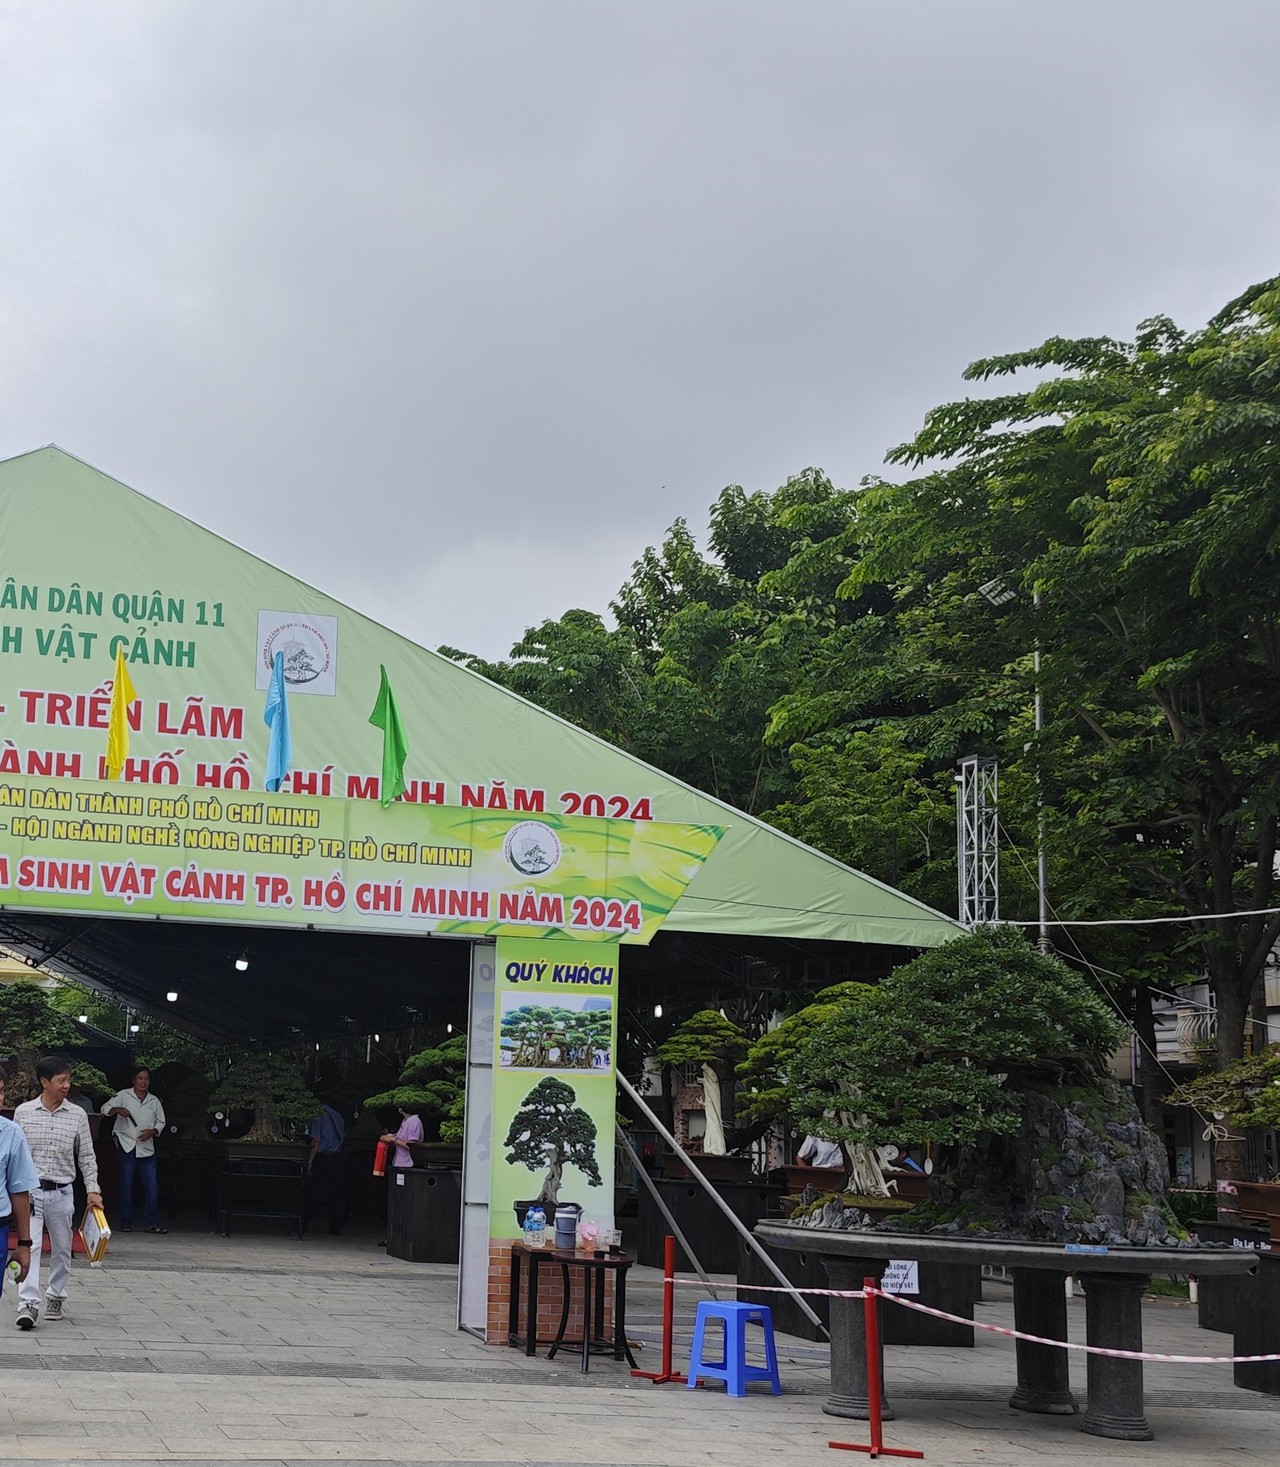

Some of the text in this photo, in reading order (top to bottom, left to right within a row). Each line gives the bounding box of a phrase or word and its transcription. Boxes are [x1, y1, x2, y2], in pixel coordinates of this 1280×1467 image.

[48, 583, 103, 616] DÂN
[112, 590, 184, 627] QUẬN
[195, 601, 225, 628] 11
[35, 624, 97, 663] VẬT
[109, 627, 196, 668] CẢNH
[158, 696, 244, 740] LÃM
[29, 787, 74, 811] DÂN
[76, 789, 143, 816] THÀNH
[148, 794, 189, 820] PHỐ
[193, 797, 223, 823] HỒ
[226, 799, 261, 825] CHÍ
[266, 805, 320, 829] MINH
[196, 752, 250, 790] HỒ
[347, 775, 445, 805] MNH
[461, 780, 545, 813] NĂM
[560, 792, 654, 821] 2024
[11, 815, 48, 842] HỘI
[52, 816, 122, 844] NGÀNH
[127, 822, 181, 849] NGHỀ
[184, 827, 238, 852] NÔNG
[243, 832, 316, 859] NGHIỆP
[319, 840, 346, 860] TP.
[349, 836, 377, 862] HỒ
[381, 842, 417, 865] CHÍ
[421, 847, 472, 868] MINH
[20, 859, 90, 892] SINH
[101, 861, 156, 901] VẬT
[163, 860, 245, 900] CẢNH
[255, 876, 293, 904] TP.
[304, 869, 346, 908] HỒ
[356, 875, 402, 911] CHÍ
[412, 887, 489, 918] MINH
[499, 888, 563, 923] NĂM
[572, 900, 641, 930] 2024
[505, 958, 548, 983] QUÝ
[552, 961, 614, 986] KHÁCH
